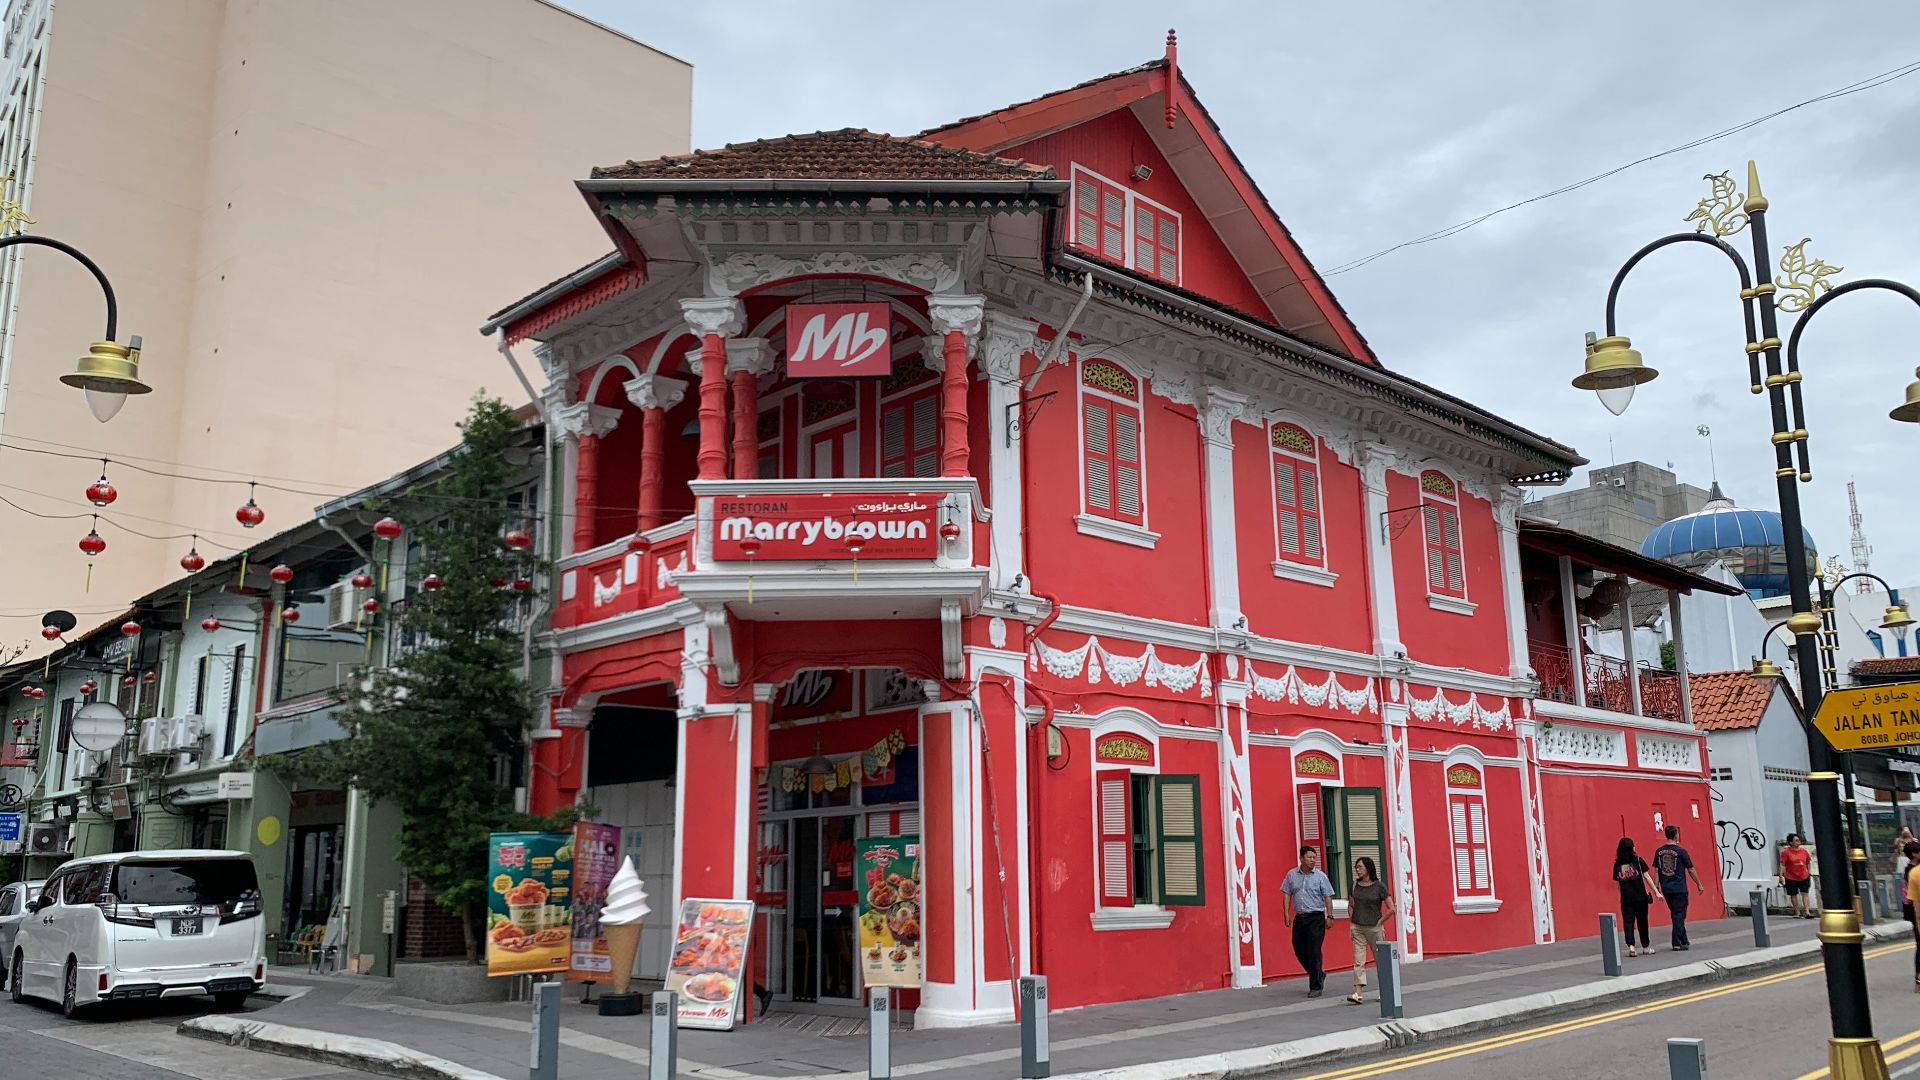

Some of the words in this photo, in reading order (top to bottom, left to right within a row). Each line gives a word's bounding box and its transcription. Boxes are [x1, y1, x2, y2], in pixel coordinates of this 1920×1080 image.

[790, 312, 887, 367] Mb
[721, 502, 788, 513] RESTORAN
[1834, 712, 1882, 732] JALAN
[1890, 709, 1920, 727] TAN
[1861, 733, 1889, 744] 80888
[178, 926, 197, 935] 3377
